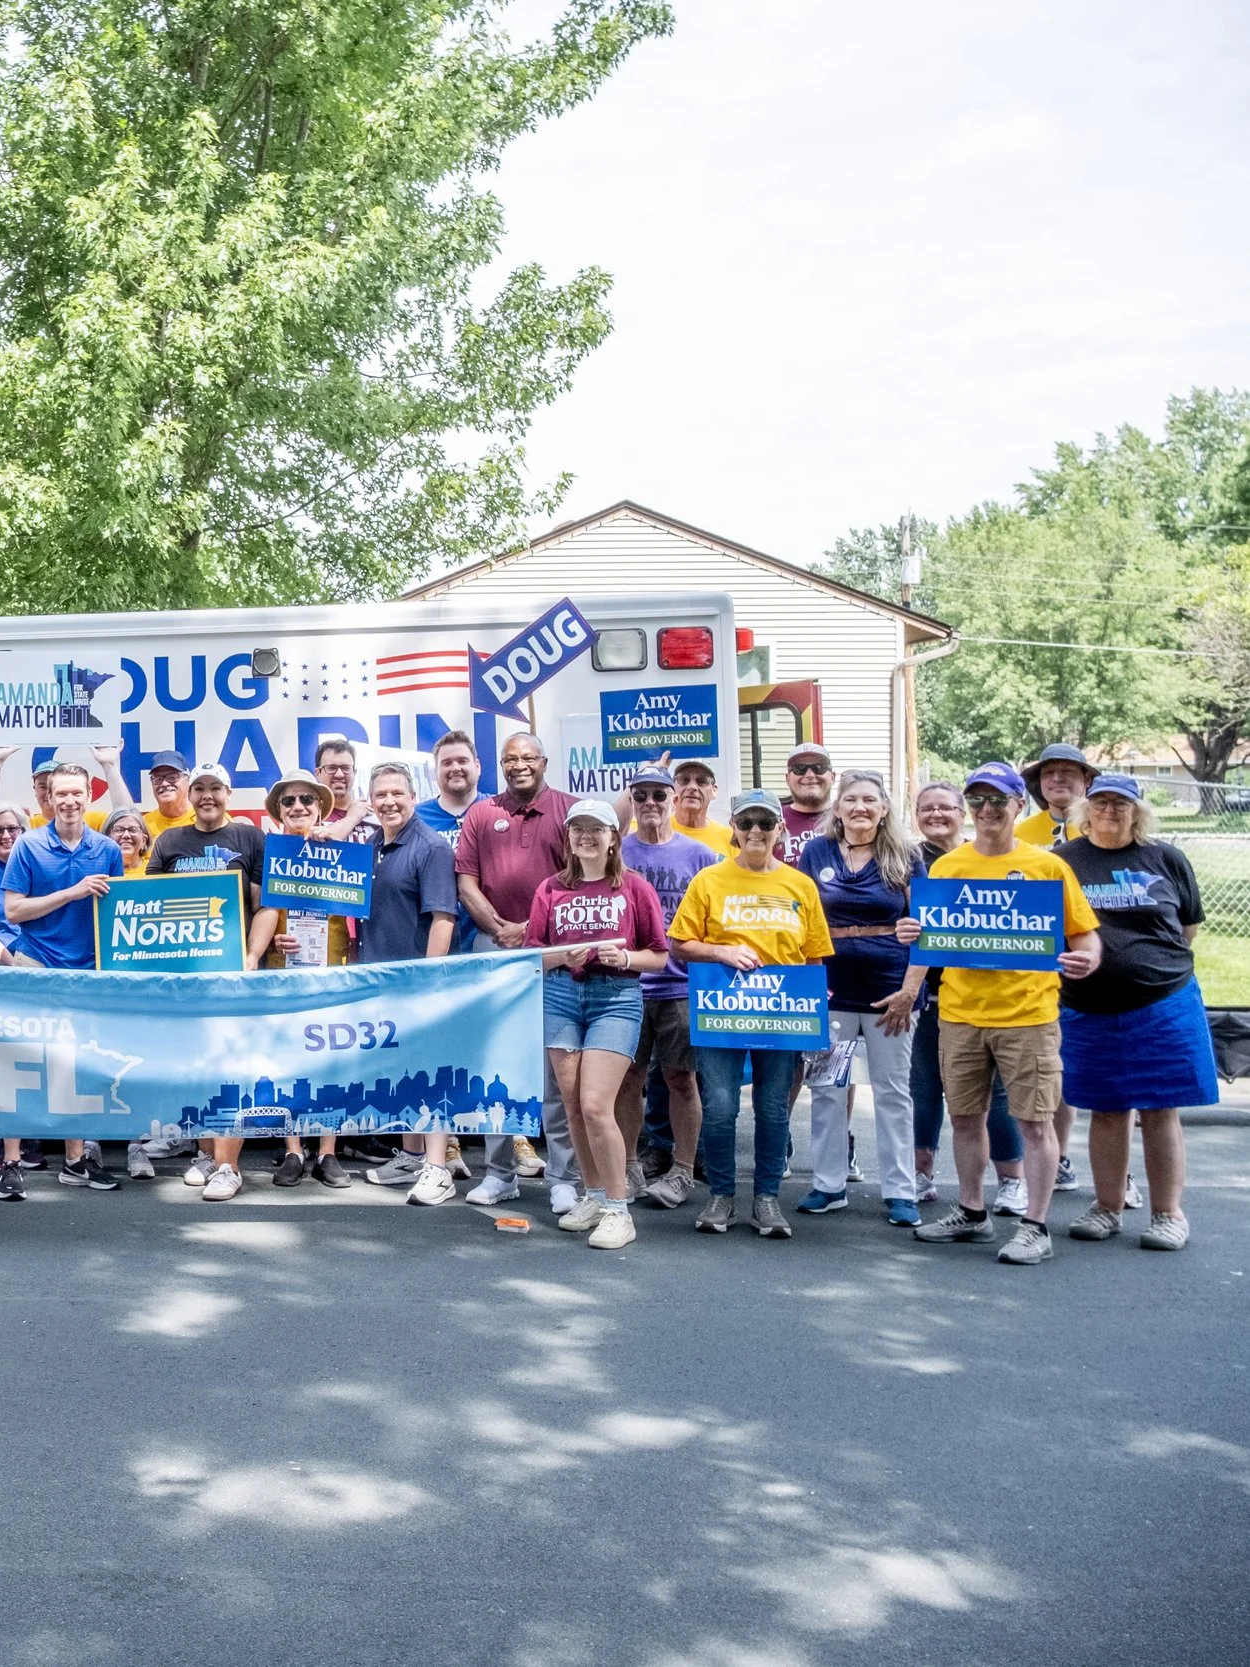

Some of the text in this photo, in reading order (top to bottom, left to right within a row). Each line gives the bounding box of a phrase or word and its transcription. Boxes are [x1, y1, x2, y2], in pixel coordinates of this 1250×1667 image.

[481, 608, 587, 705] DOUG
[74, 691, 89, 699] STATE
[634, 692, 681, 712] Amy
[607, 709, 711, 732] Klobuchar
[615, 733, 705, 748] FOR GOVERNOR
[568, 769, 637, 793] MATCH
[297, 841, 343, 866] Amy
[268, 857, 367, 886] Klobuchar
[273, 881, 359, 902] FOR GOVERNOR
[572, 895, 609, 907] Chris
[724, 894, 758, 905] Matt
[955, 883, 1018, 915] Amy
[115, 899, 161, 916] Matt
[554, 898, 620, 930] Ford
[721, 904, 800, 927] NORRIS
[918, 906, 1056, 932] Klobuchar
[111, 917, 225, 947] NORRIS
[563, 923, 588, 931] STATE
[588, 922, 619, 931] SENATE
[112, 947, 223, 961] For Minnesota House
[927, 936, 1046, 953] FOR GOVERNOR
[728, 969, 786, 994] Amy
[696, 989, 821, 1013] Klobuchar
[303, 1020, 399, 1052] SD32
[705, 1017, 813, 1032] FOR GOVERNOR
